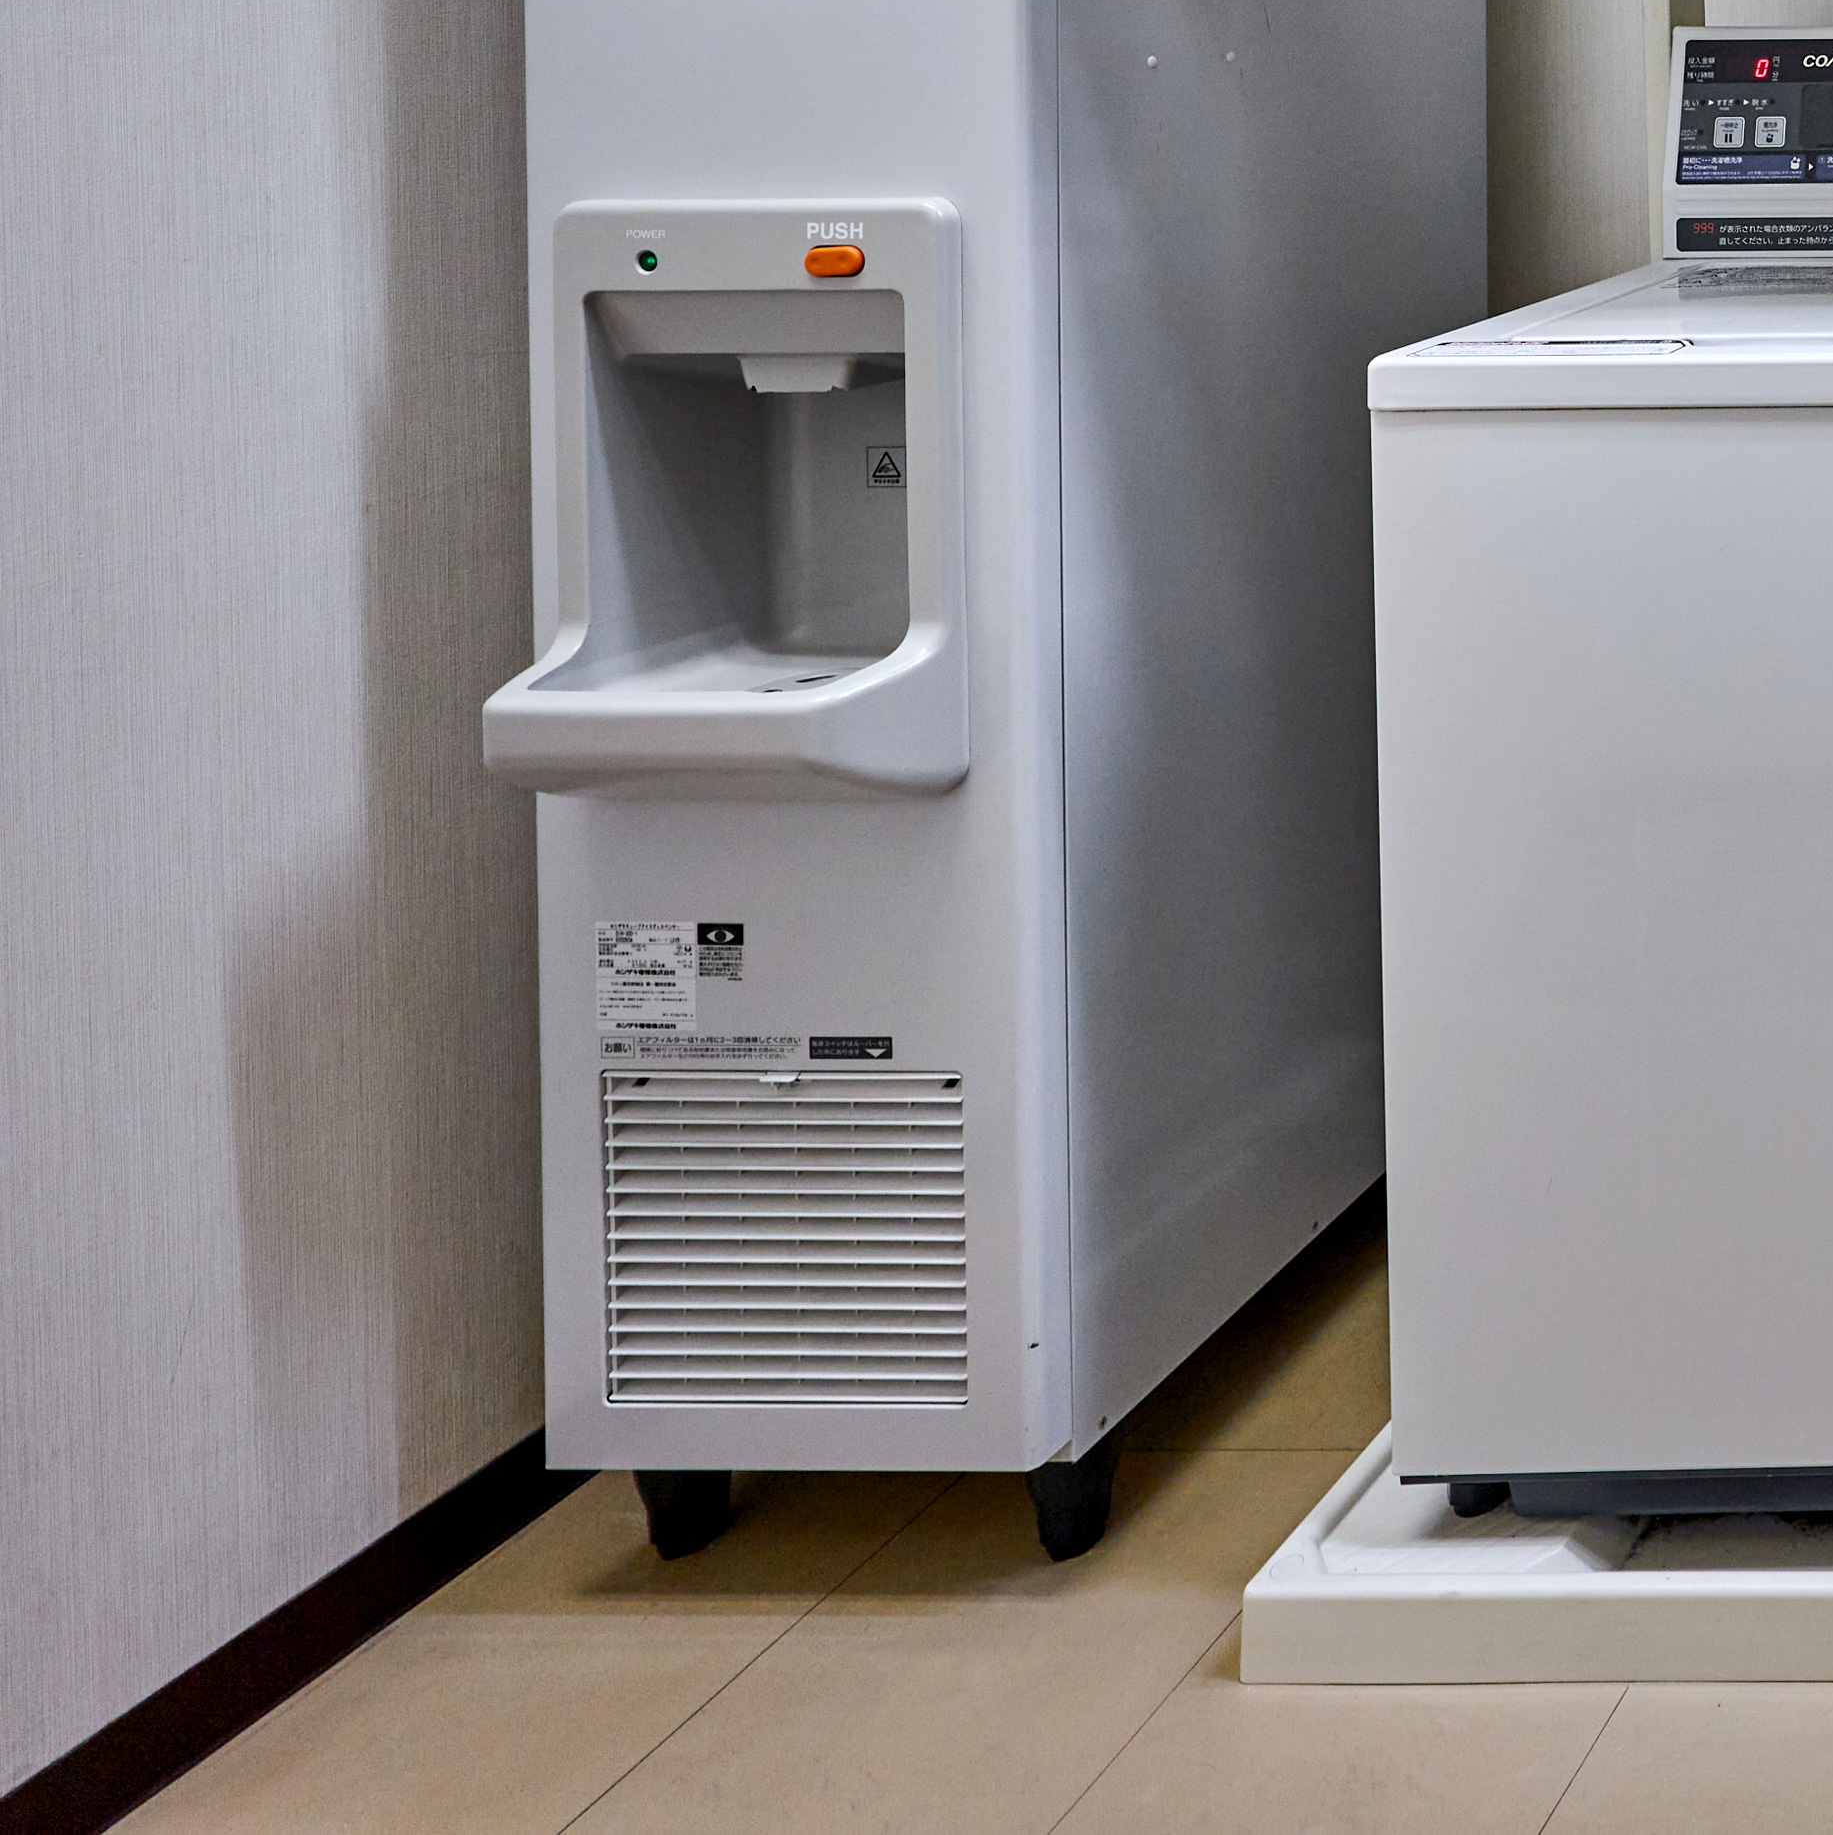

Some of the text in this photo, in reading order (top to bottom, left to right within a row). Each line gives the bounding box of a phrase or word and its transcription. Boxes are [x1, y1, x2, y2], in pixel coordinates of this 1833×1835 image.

[1755, 59, 1769, 78] 0
[807, 223, 864, 239] PUSH
[1694, 223, 1714, 233] 999
[626, 230, 666, 239] POWER
[605, 1042, 632, 1054] お願い
